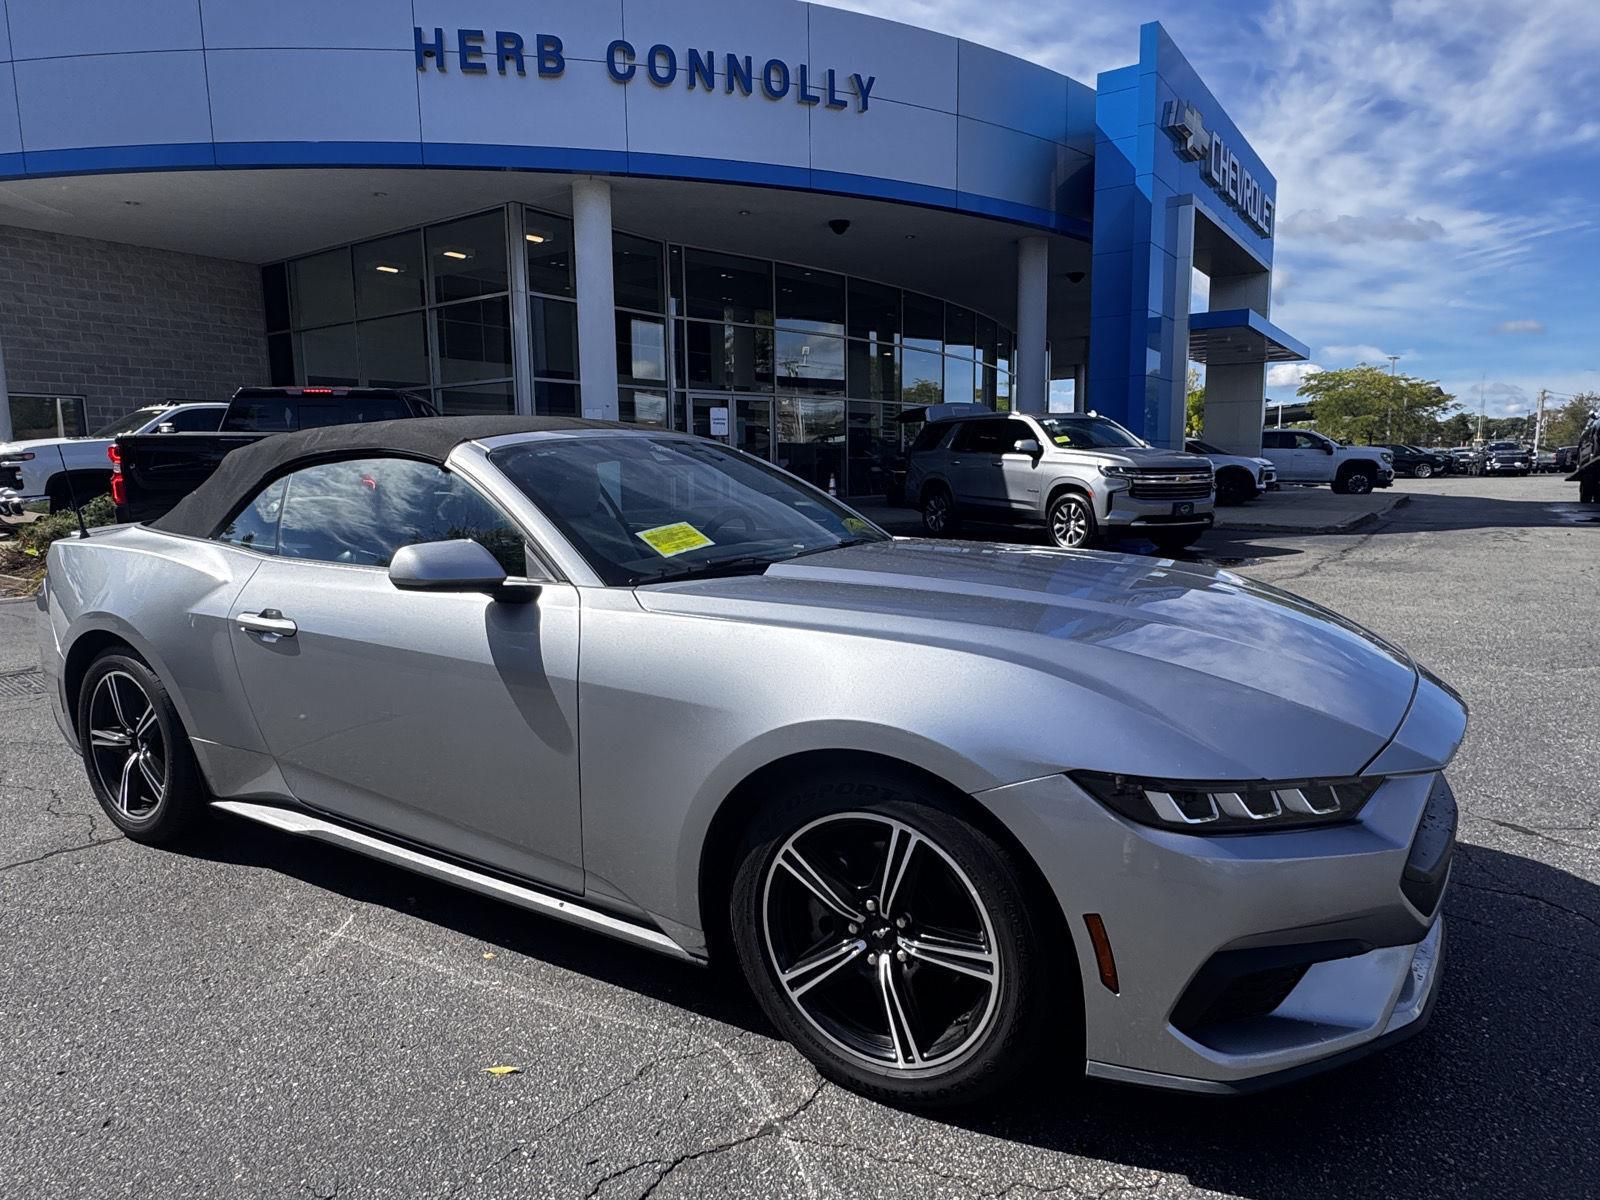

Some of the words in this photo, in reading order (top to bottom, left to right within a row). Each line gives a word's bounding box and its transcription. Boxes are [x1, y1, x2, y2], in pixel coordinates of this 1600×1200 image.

[414, 27, 566, 77] HERB
[607, 40, 876, 113] CONNOLLY
[1208, 131, 1275, 238] CHEVROLET
